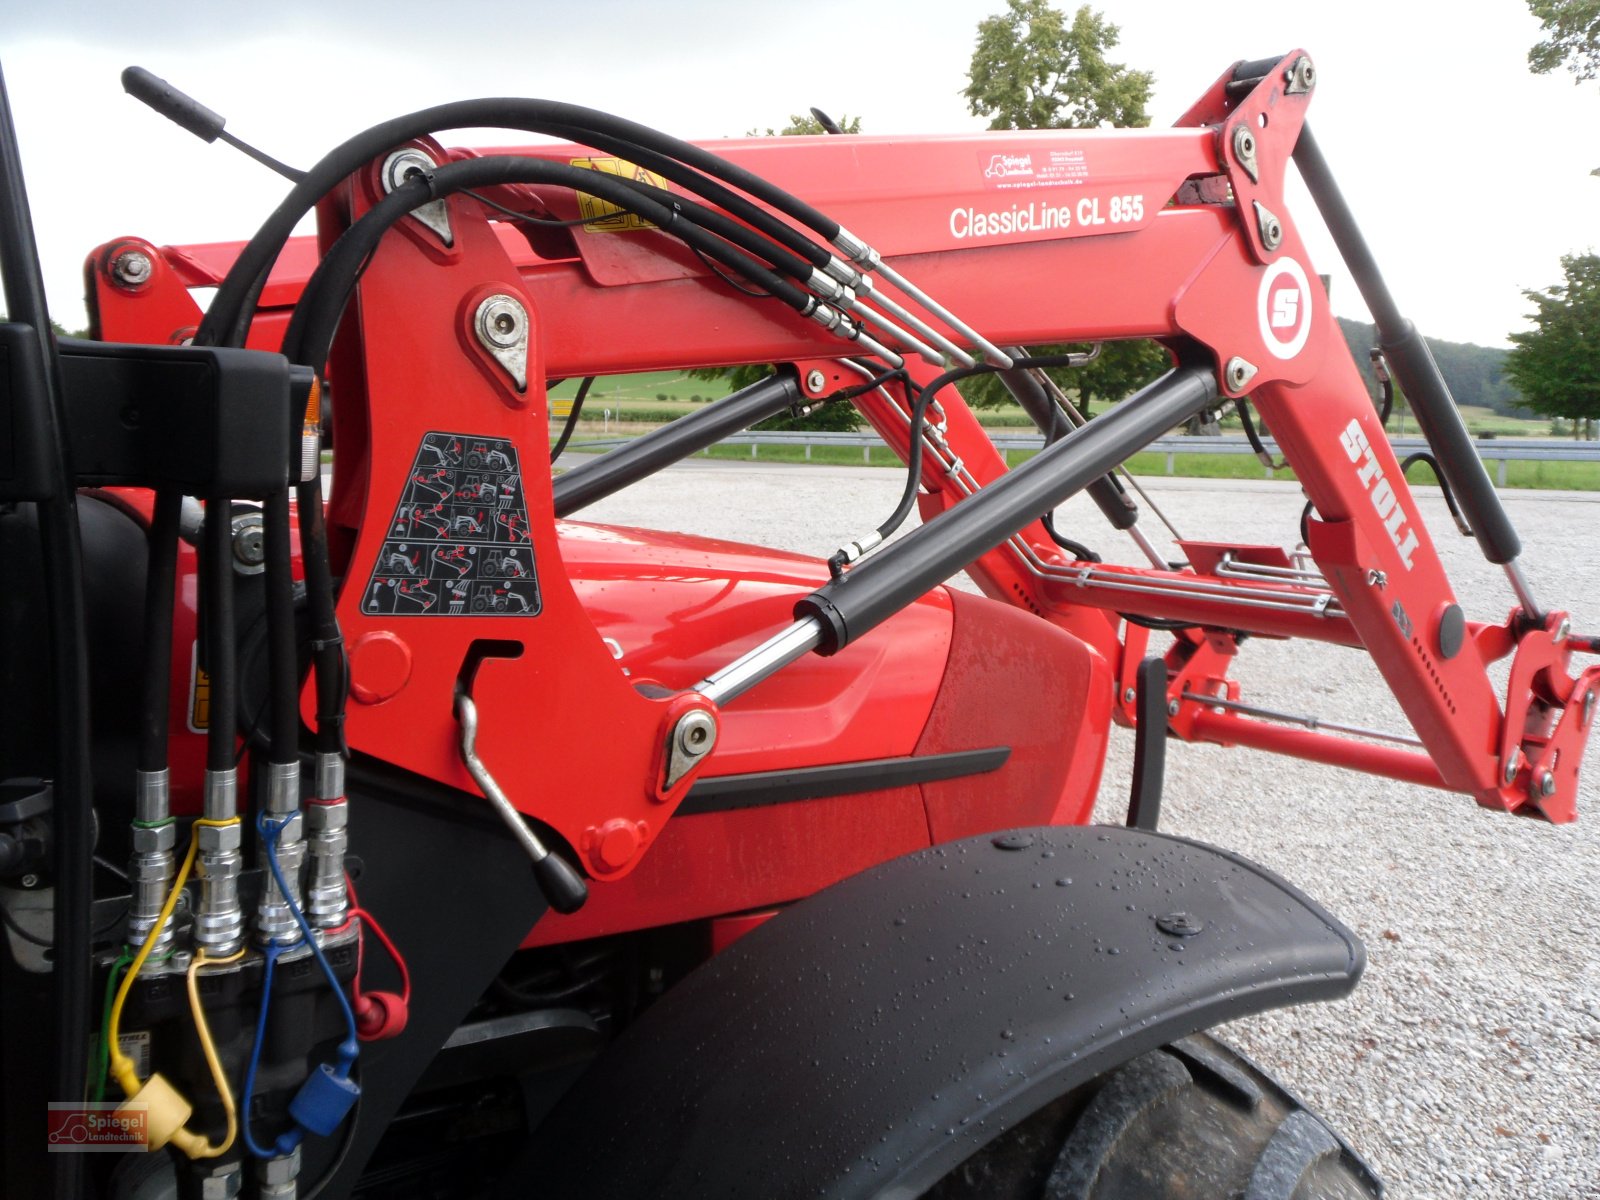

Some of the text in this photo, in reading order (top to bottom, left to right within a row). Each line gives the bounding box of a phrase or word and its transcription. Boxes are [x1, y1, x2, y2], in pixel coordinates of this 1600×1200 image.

[1002, 153, 1032, 168] Spiegel
[949, 195, 1144, 239] ClassicLine CL 855
[1271, 288, 1300, 328] S
[1339, 417, 1421, 573] STOLL
